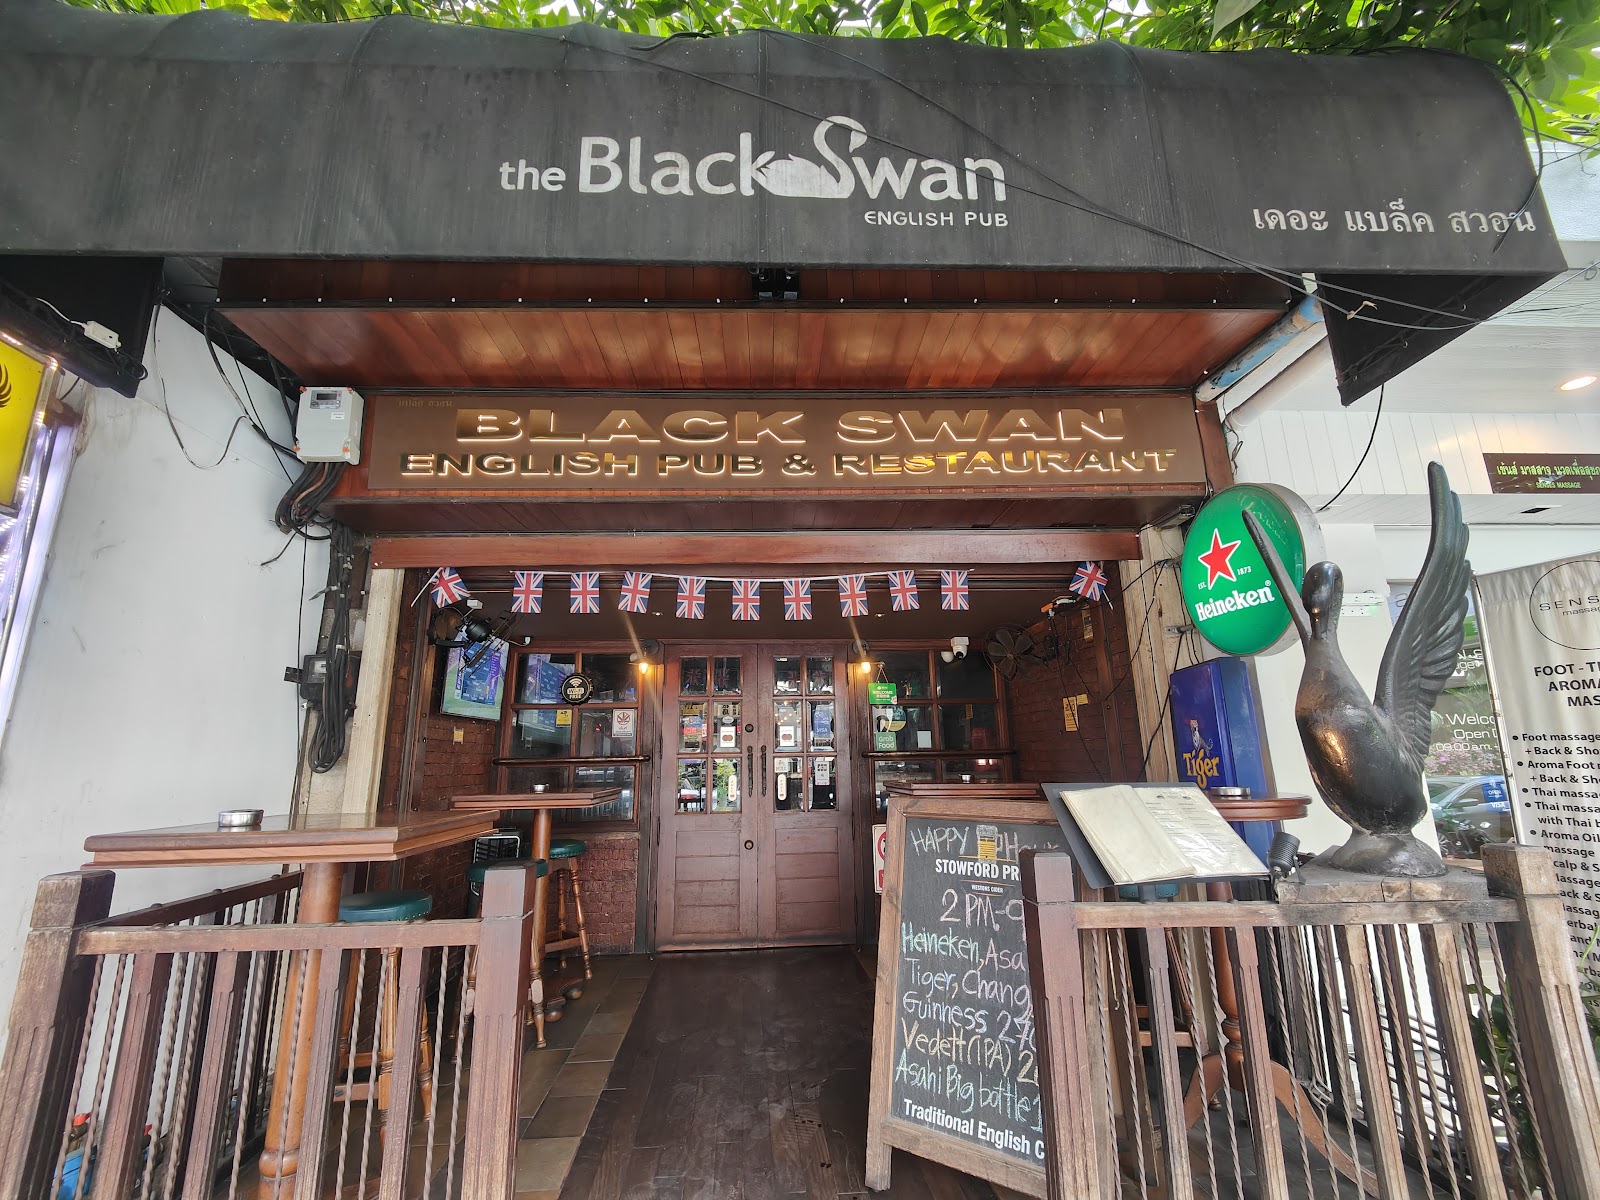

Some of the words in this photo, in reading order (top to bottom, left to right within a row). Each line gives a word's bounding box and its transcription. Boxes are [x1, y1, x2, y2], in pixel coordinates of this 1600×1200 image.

[500, 159, 566, 192] the
[578, 132, 772, 197] Black
[813, 116, 1007, 202] Swan
[864, 211, 954, 227] ENGLISH
[964, 212, 1009, 227] PUB
[1252, 207, 1329, 231] เดอะ
[1344, 197, 1435, 232] แบล็ค
[1448, 209, 1536, 233] สวอน
[455, 409, 806, 444] BLACK
[836, 408, 1125, 443] SWAN
[401, 451, 638, 477] ENGLISH
[657, 452, 764, 477] PUB
[781, 453, 816, 476] &
[833, 449, 1177, 475] RESTAURANT
[1237, 566, 1252, 576] 1873
[1195, 586, 1275, 621] Heineken
[1539, 595, 1600, 612] SENS
[1534, 663, 1575, 677] FOOT
[1567, 695, 1600, 707] MAS
[1445, 713, 1496, 725] Welco
[1454, 729, 1490, 741] Open
[1522, 733, 1548, 741] Foot
[1534, 747, 1562, 755] Back
[1564, 747, 1573, 755] &
[1576, 746, 1600, 755] Sho
[1183, 749, 1220, 789] Tiger
[1528, 760, 1564, 769] Aroma
[1566, 761, 1596, 769] Foot
[1539, 774, 1568, 783] Back
[1569, 775, 1579, 783] &
[1582, 775, 1600, 784] Sh
[1532, 788, 1557, 796] Thai
[1560, 790, 1600, 798] massa
[1534, 802, 1560, 811] Thai
[1562, 805, 1600, 813] massa
[1538, 816, 1563, 825] with
[1565, 817, 1591, 828] Thai
[910, 826, 970, 856] HAPPY
[1541, 830, 1580, 841] Aroma
[935, 859, 999, 879] STOWFORD
[1003, 865, 1021, 881] PR
[1553, 860, 1577, 871] calp
[1580, 861, 1590, 871] &
[1592, 863, 1600, 872] S
[1559, 889, 1580, 899] ack
[1583, 891, 1592, 901] &
[940, 889, 961, 922] 2
[1562, 903, 1600, 919] assag
[985, 938, 1027, 971] Asa
[903, 991, 989, 1034] Guinness
[895, 1048, 942, 1097] Asahi
[946, 1064, 975, 1114] Big
[979, 1072, 1031, 1122] bottle
[1030, 1093, 1043, 1134] 1
[904, 1099, 974, 1136] Traditional
[978, 1121, 1030, 1155] English
[1034, 1140, 1045, 1160] C
